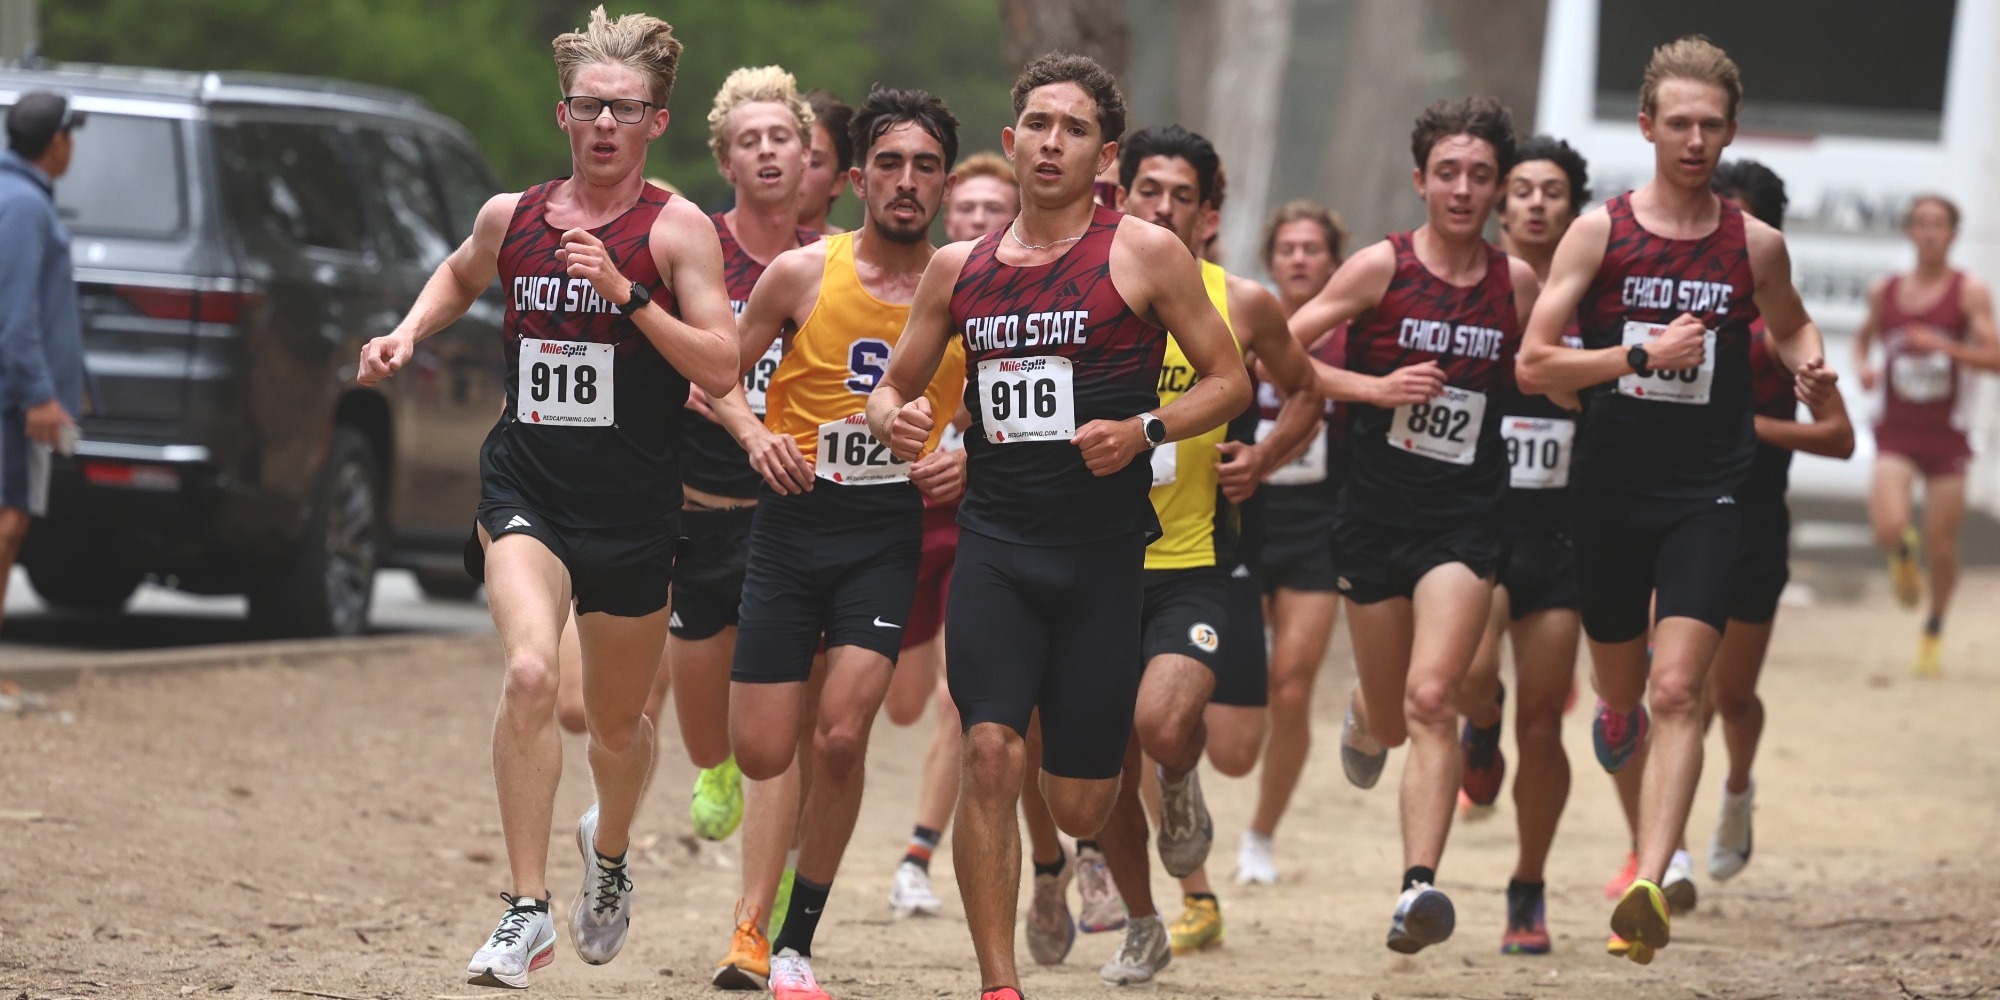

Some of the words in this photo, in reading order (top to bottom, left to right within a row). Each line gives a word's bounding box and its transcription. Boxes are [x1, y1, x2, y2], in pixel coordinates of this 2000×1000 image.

[514, 276, 561, 312] CHICO
[564, 278, 622, 315] STA
[1623, 276, 1674, 309] CHICO
[1677, 280, 1733, 315] STATE
[540, 342, 588, 357] MileSplit
[965, 314, 1019, 352] CHICO
[1025, 310, 1089, 347] STATE
[1398, 317, 1451, 353] CHICO
[1452, 324, 1504, 361] STATE
[531, 361, 598, 405] 918
[999, 358, 1047, 373] MileSplit
[542, 414, 597, 423] REDCAPTIMING.COM
[991, 377, 1057, 421] 916
[1007, 430, 1058, 438] REDCAPTIMING.COM
[1408, 402, 1470, 443] 892
[824, 431, 907, 466] 162
[1505, 436, 1560, 470] 910
